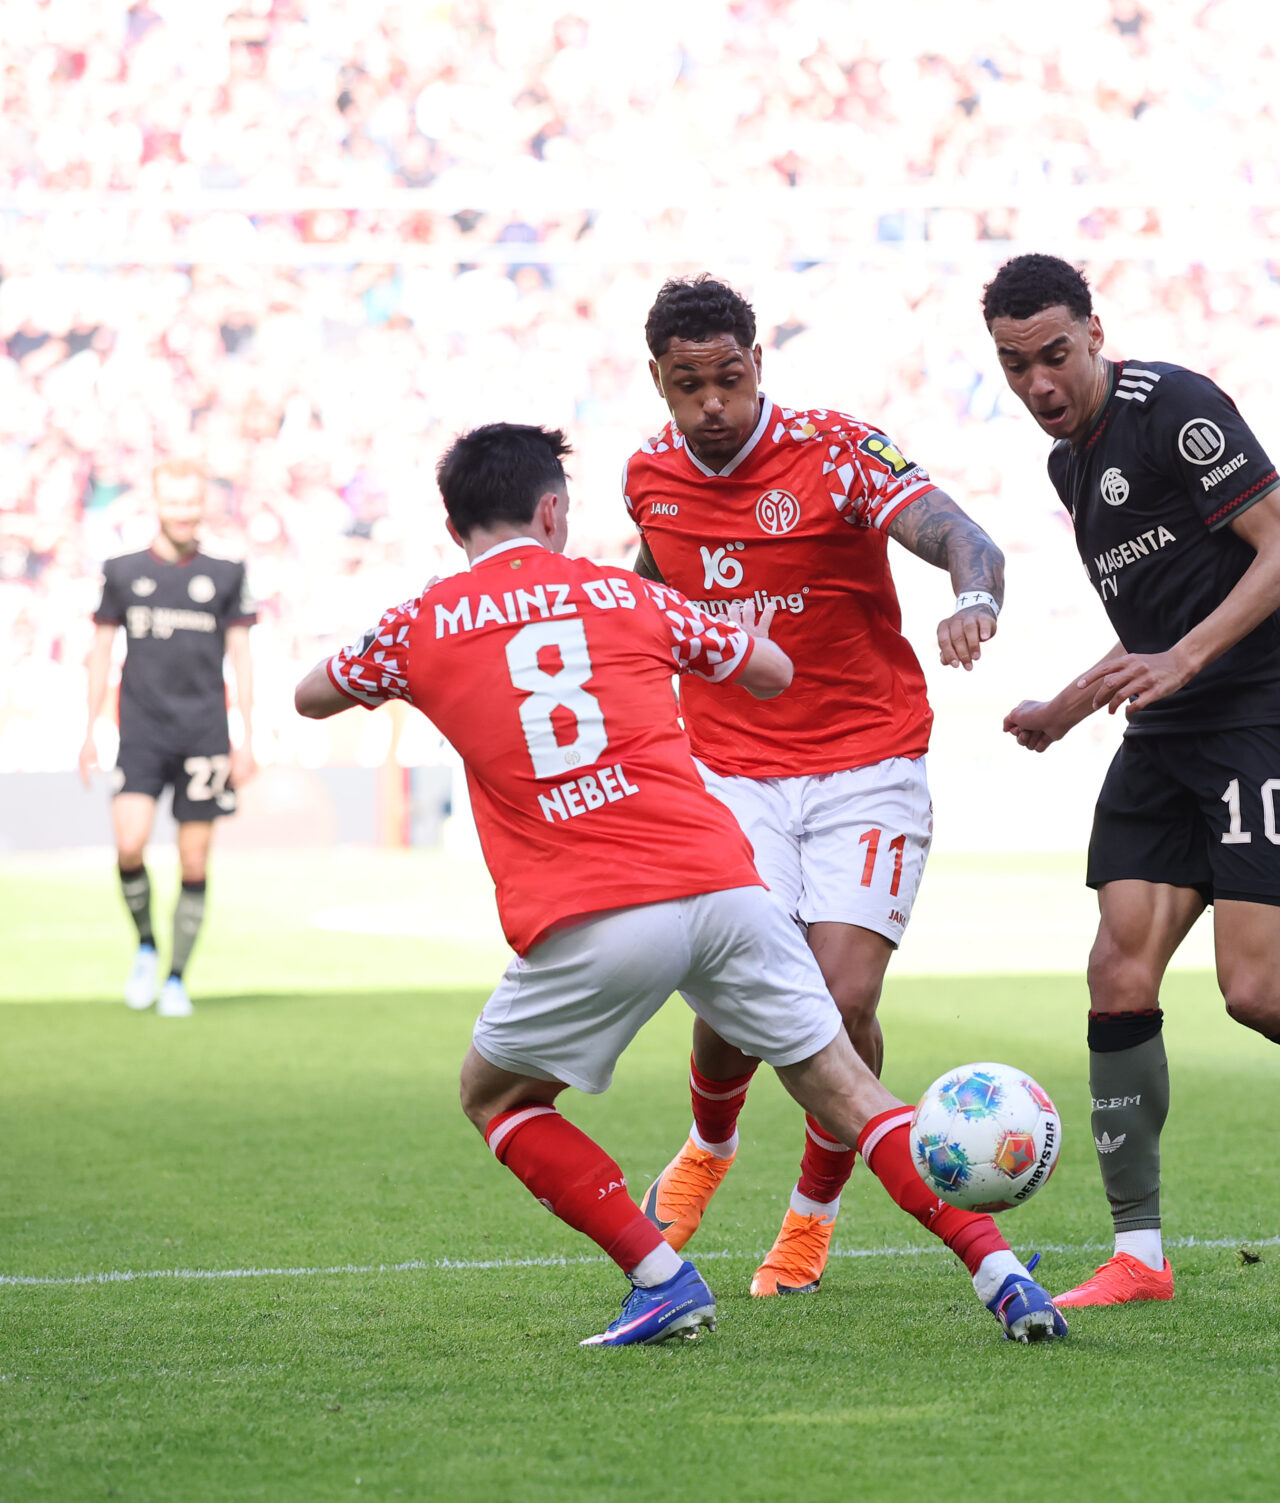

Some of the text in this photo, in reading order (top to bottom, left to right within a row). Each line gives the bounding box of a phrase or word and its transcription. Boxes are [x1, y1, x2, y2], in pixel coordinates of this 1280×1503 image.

[1200, 452, 1248, 492] Allianz
[650, 503, 679, 516] JAKO
[1094, 525, 1177, 577] MAGENTA
[434, 578, 637, 639] MAINZ 05
[1100, 575, 1118, 601] TV
[505, 618, 609, 779] 8
[184, 754, 231, 801] 27
[537, 763, 640, 823] NEBEL
[858, 828, 906, 897] 11
[1014, 1121, 1055, 1200] DERBYSTAR
